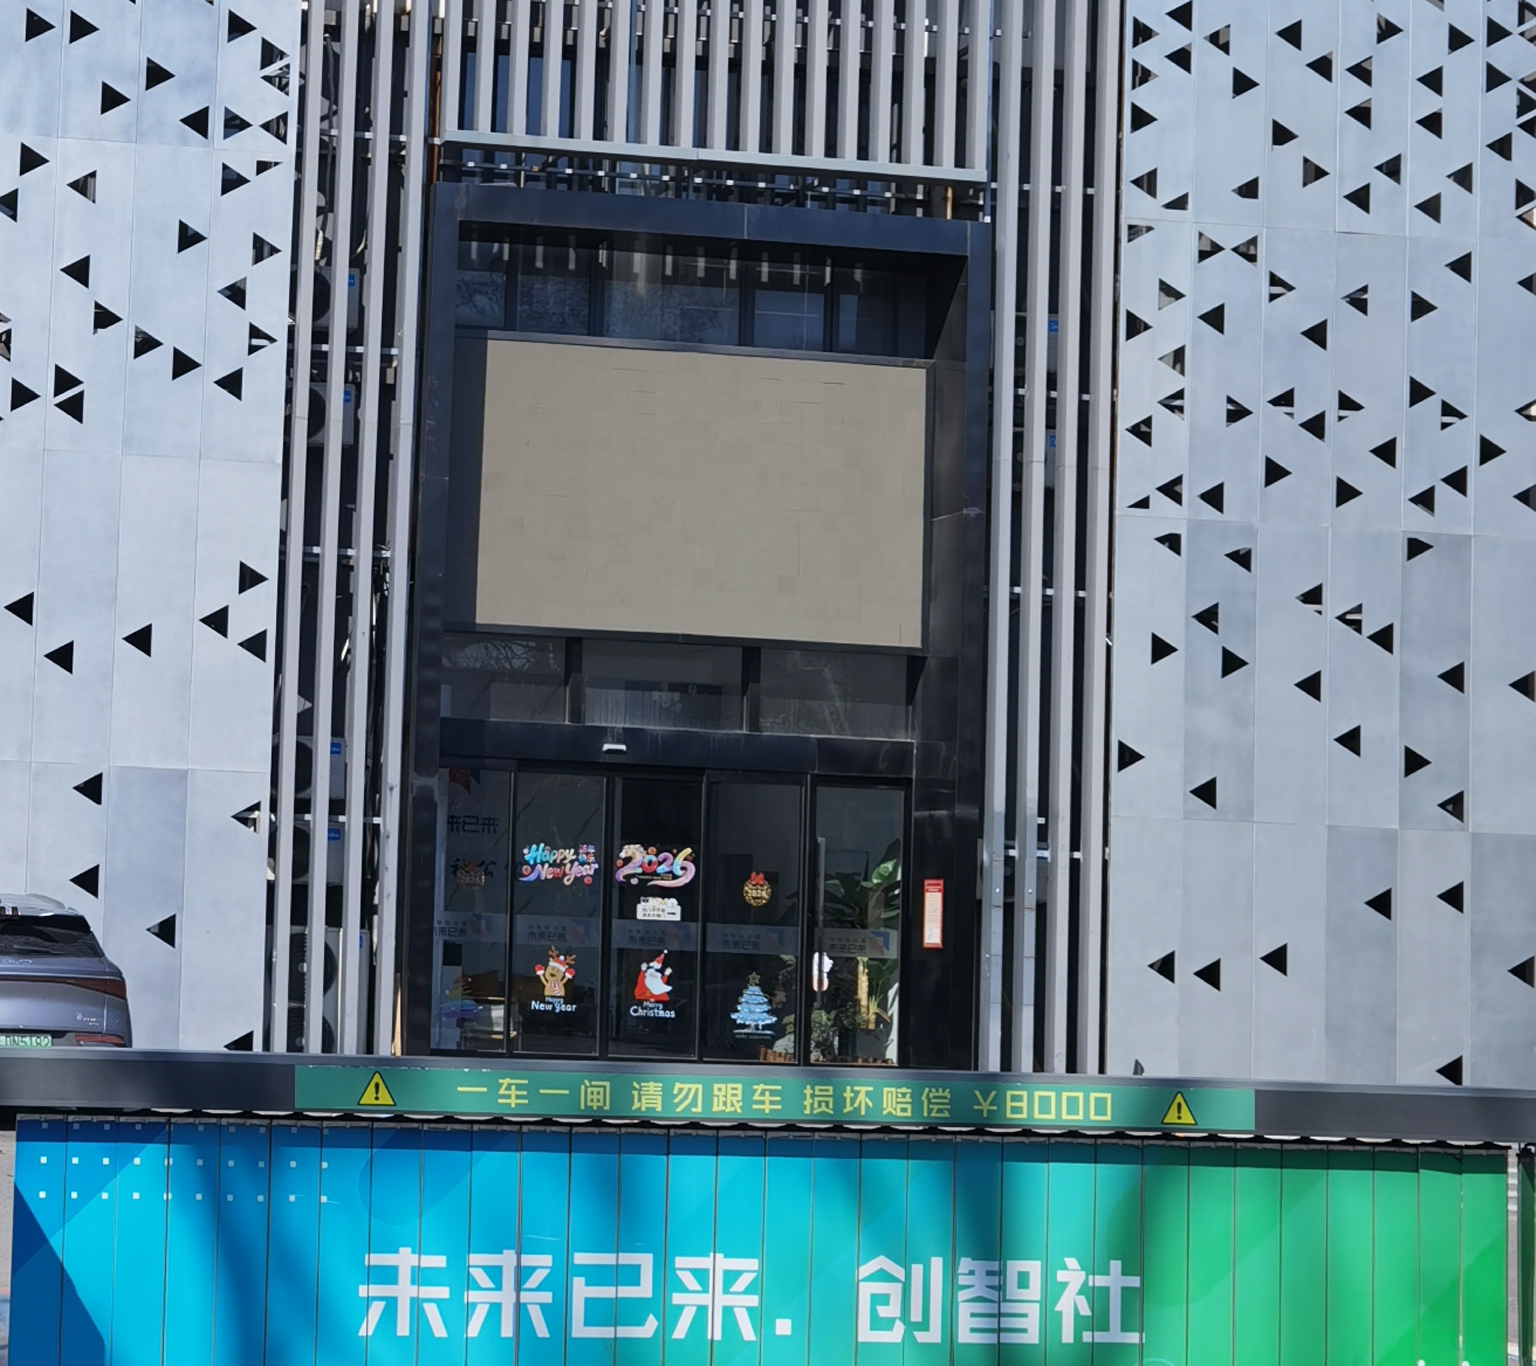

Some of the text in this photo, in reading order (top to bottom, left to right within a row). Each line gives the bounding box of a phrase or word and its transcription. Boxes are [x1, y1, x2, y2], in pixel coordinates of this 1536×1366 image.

[457, 1078, 612, 1111] 一车一闸
[632, 1081, 782, 1114] 请勿跟车
[803, 1085, 952, 1118] 损坏赔偿
[855, 1255, 1146, 1344] 创智社
